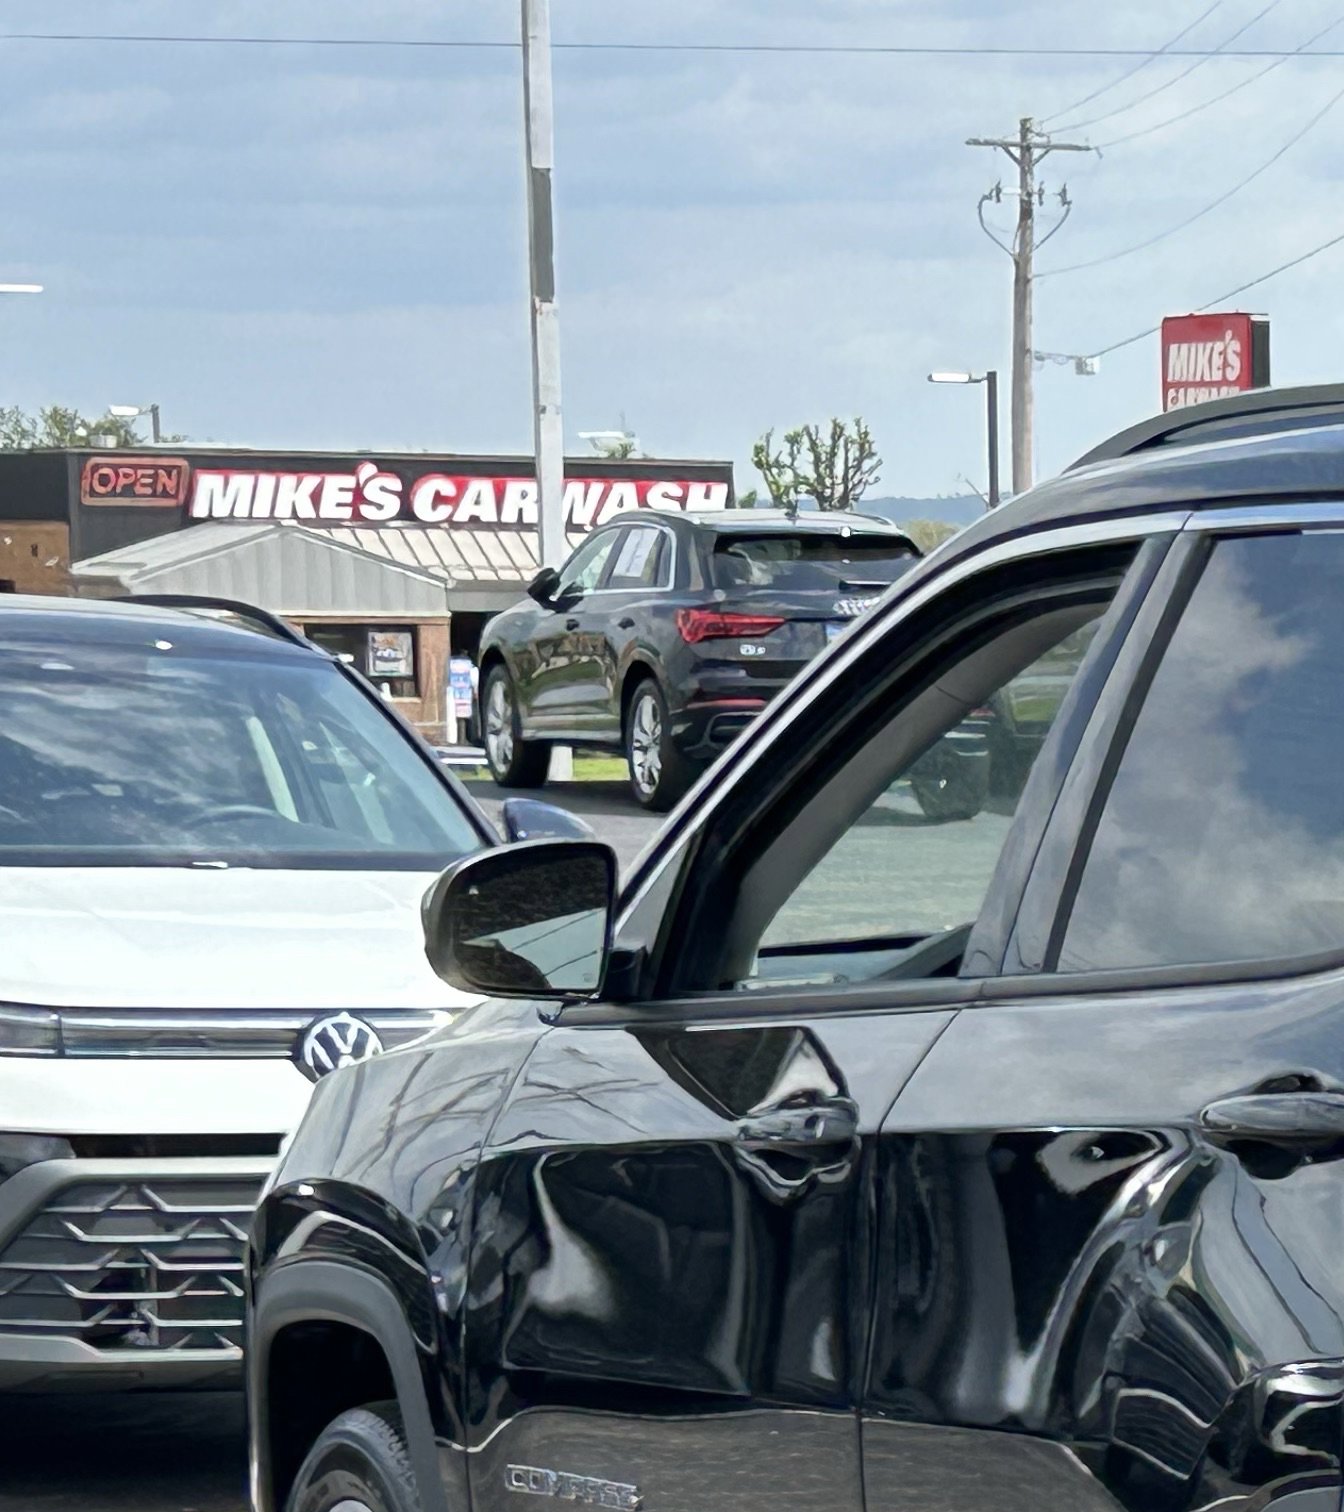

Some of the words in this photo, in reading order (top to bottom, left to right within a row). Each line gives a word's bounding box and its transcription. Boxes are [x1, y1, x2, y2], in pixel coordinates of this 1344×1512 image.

[1167, 329, 1241, 382] MIKE'S
[91, 467, 178, 496] OPEN
[190, 461, 402, 520] MIKE'S
